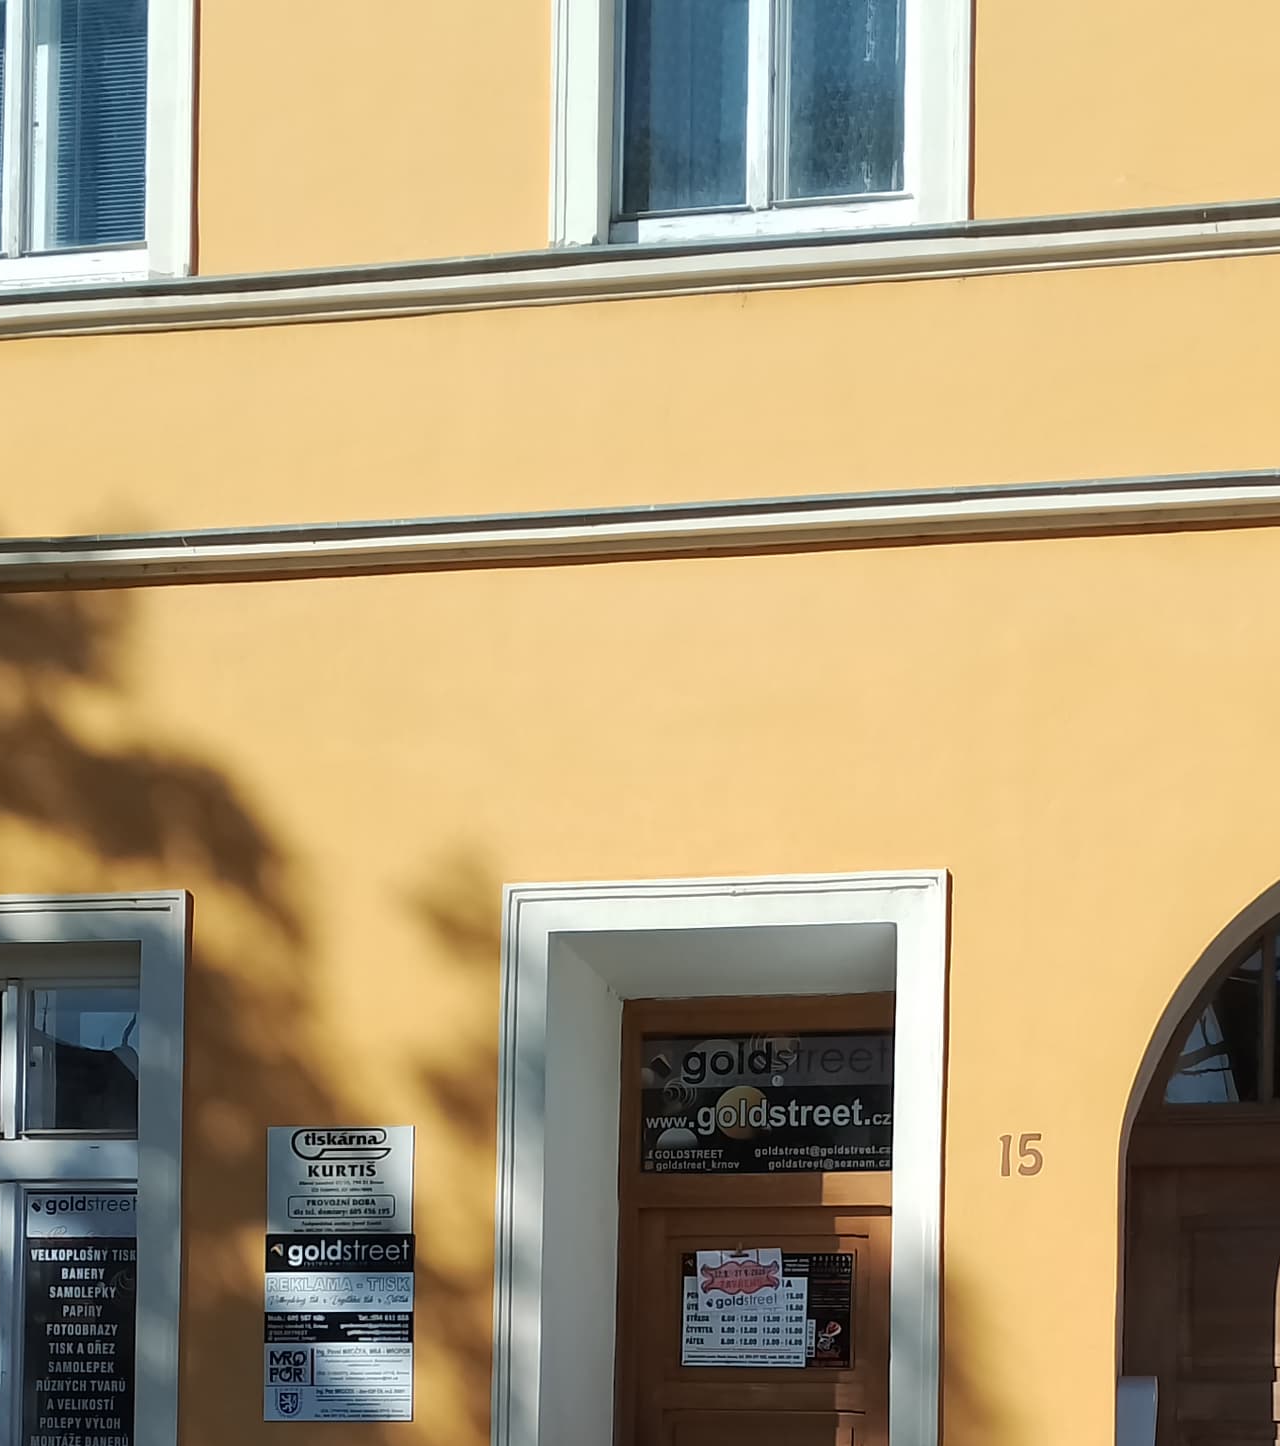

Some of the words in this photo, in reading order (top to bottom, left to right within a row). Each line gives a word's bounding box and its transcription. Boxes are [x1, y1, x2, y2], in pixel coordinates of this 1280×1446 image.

[681, 1040, 891, 1084] goldstreet
[645, 1097, 892, 1136] www.goldstreet.cz
[304, 1132, 379, 1146] tiskárna
[654, 1149, 724, 1160] GOLDSTREET
[999, 1132, 1043, 1176] 15
[308, 1161, 377, 1177] KURTIŠ
[655, 1160, 741, 1172] goldstreet_krnov
[45, 1196, 138, 1215] goldstreet
[287, 1239, 410, 1267] goldstreet
[61, 1267, 105, 1280] BANERY
[267, 1277, 353, 1292] REKLAMA
[367, 1277, 410, 1291] TISK
[49, 1286, 116, 1299] SAMOLEPKY
[715, 1293, 778, 1309] goldstreet
[62, 1302, 103, 1317] PAPÍRY
[46, 1323, 118, 1336] FOTOOBRAZY
[48, 1342, 73, 1354] TISK
[76, 1342, 85, 1354] A
[87, 1340, 115, 1354] OŘEZ
[48, 1361, 114, 1373] SAMOLEPEK
[46, 1399, 54, 1410] A
[57, 1396, 115, 1410] VELIKOSTÍ
[40, 1417, 81, 1429] POLEPY
[85, 1415, 120, 1429] VÝLOH
[30, 1433, 81, 1446] MONTÁŽE
